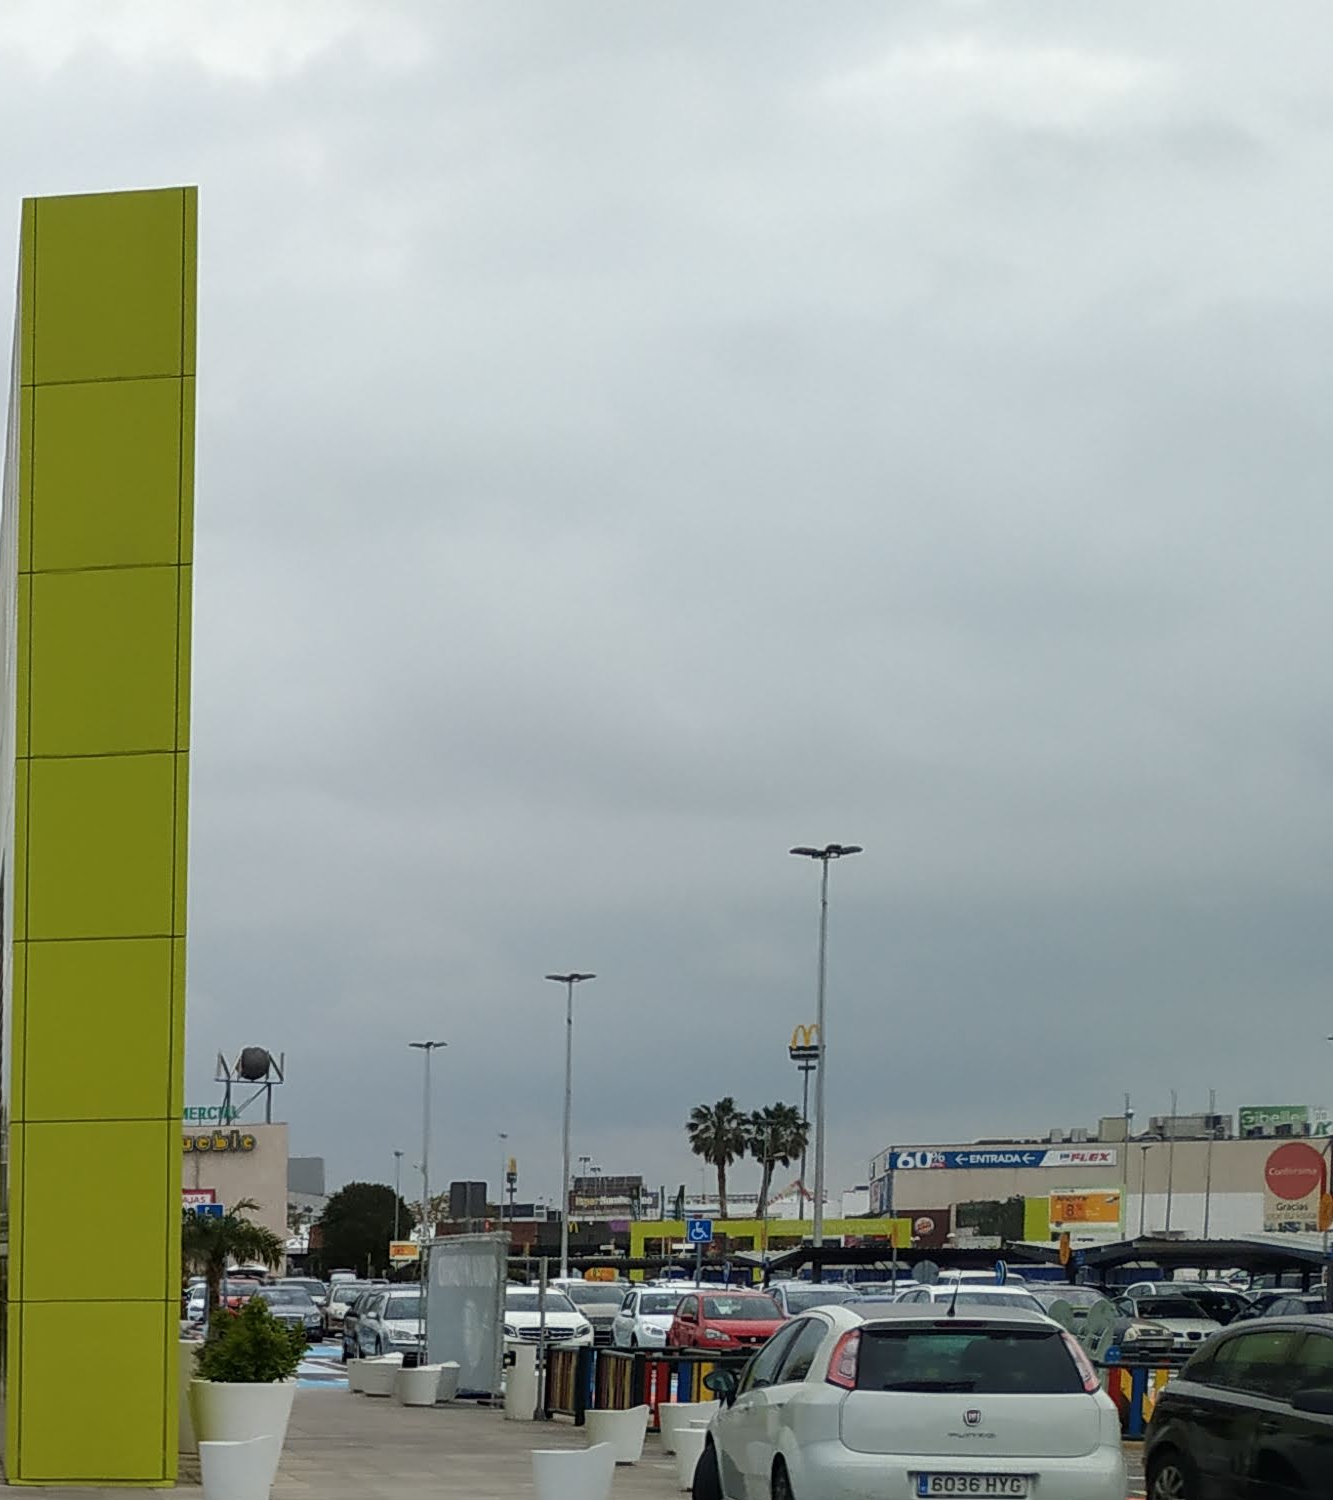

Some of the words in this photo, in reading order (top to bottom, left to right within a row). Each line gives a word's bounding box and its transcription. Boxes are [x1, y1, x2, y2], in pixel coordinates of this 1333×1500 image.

[969, 1153, 1021, 1165] ENTRADA
[1070, 1152, 1111, 1162] FLEX
[1276, 1202, 1309, 1211] Gracias
[931, 1477, 981, 1492] 6036
[985, 1477, 1022, 1492] HYG
